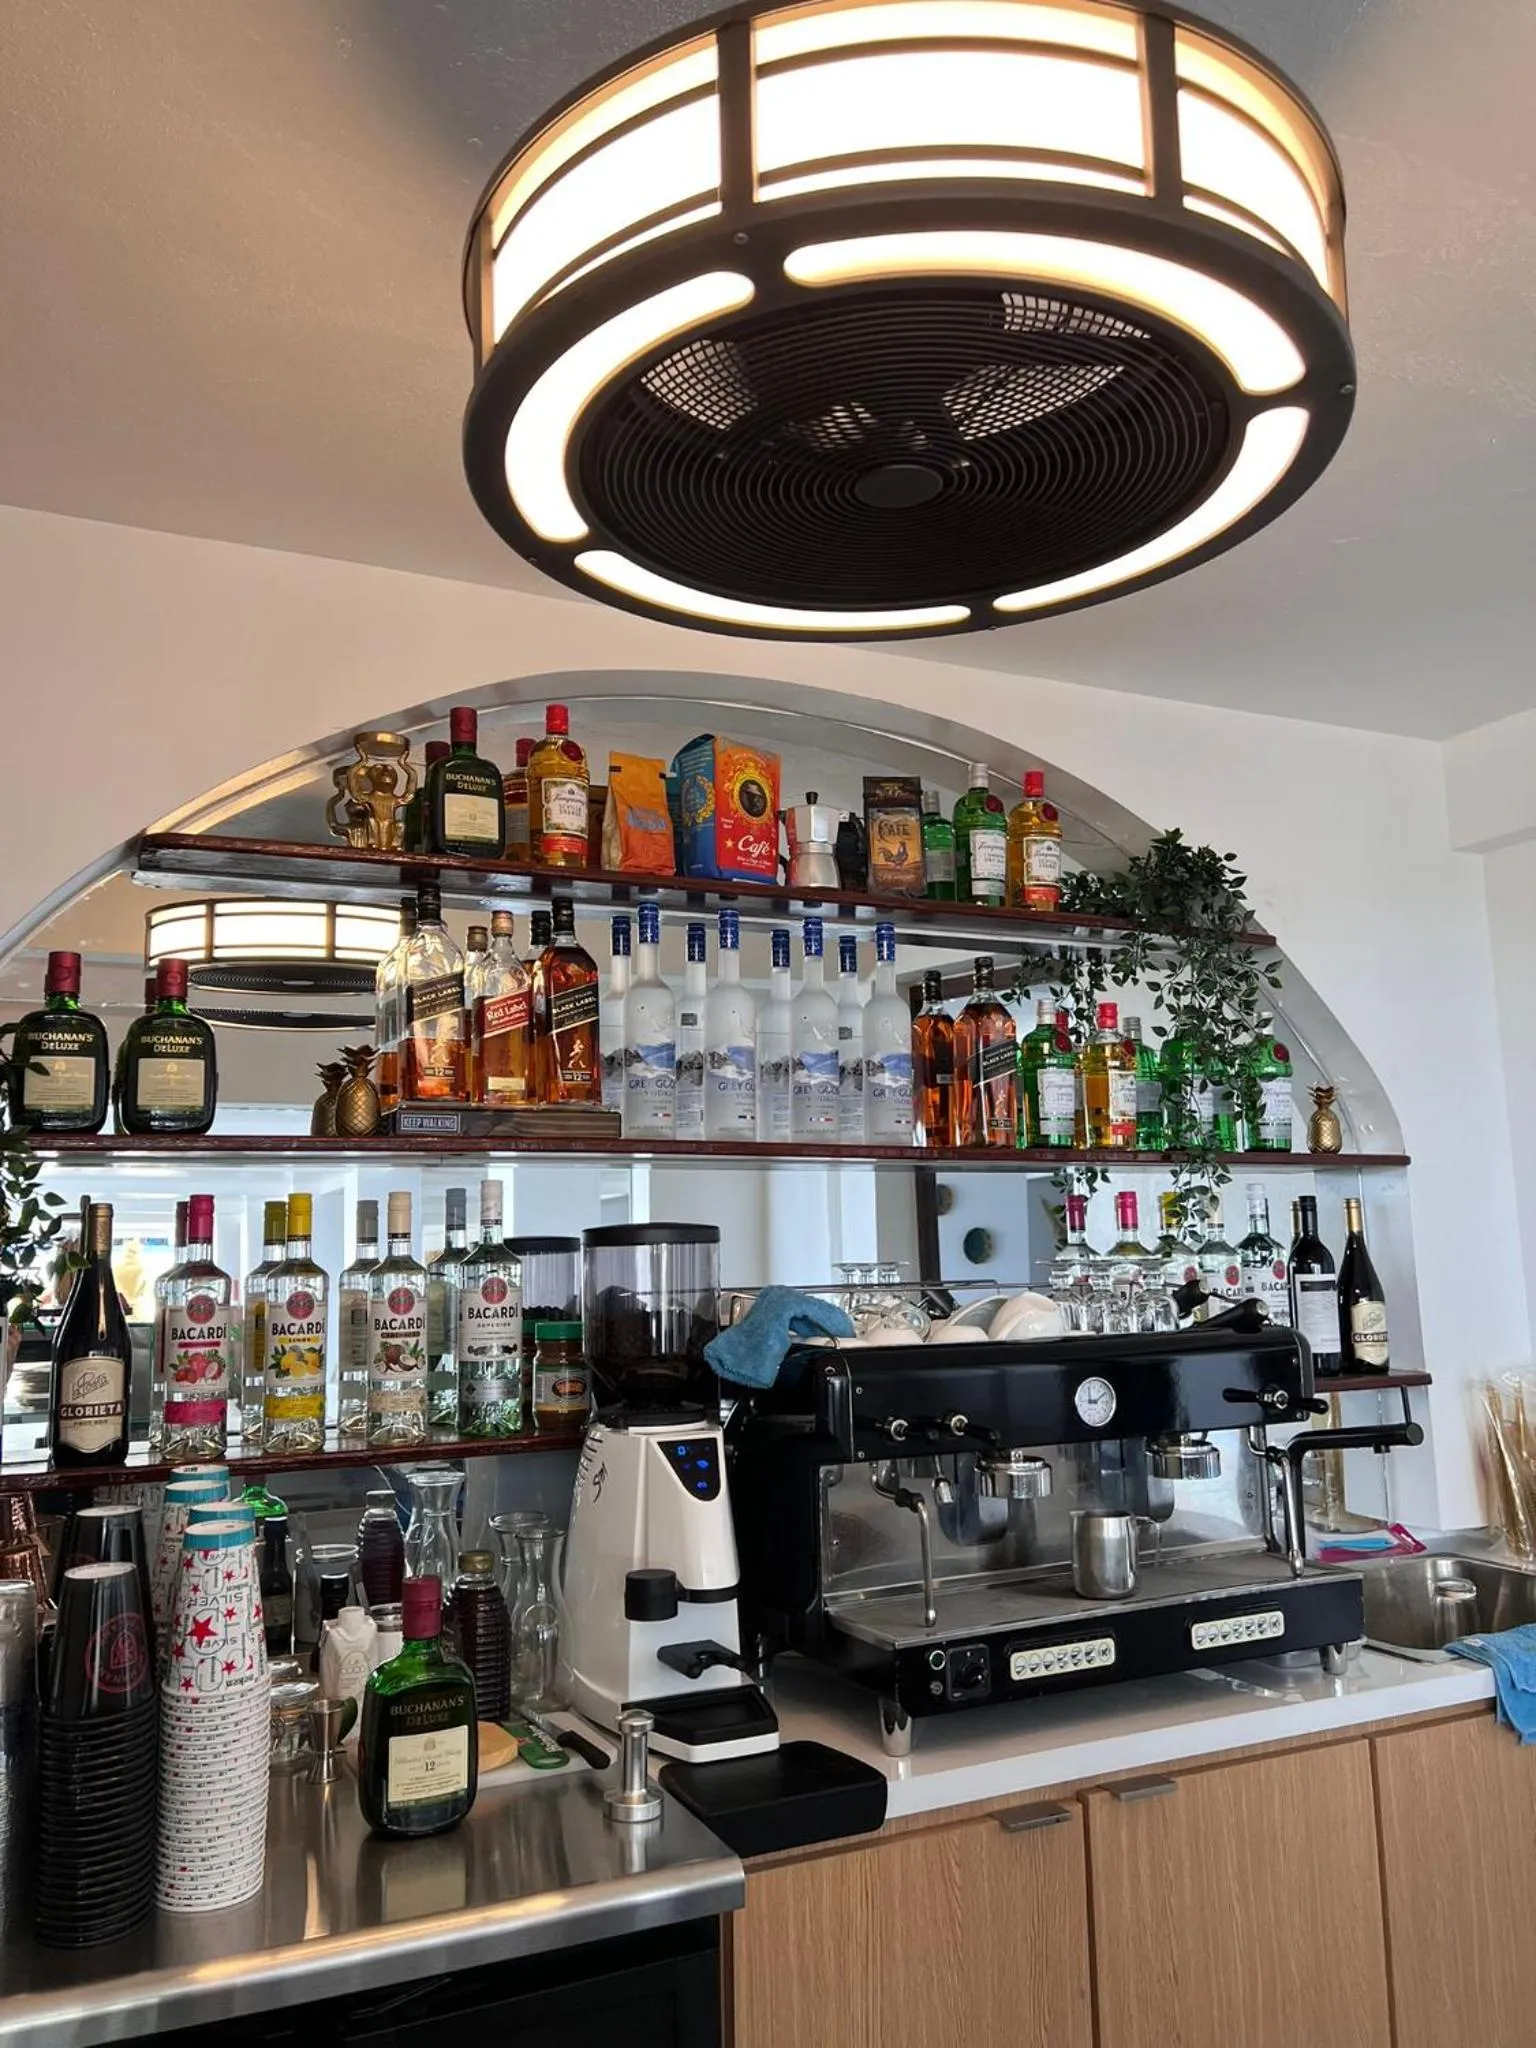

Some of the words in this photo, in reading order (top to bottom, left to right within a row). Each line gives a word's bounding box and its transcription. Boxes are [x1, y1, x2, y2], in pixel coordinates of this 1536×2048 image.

[445, 773, 496, 786] BUCHANAN'S
[737, 834, 770, 857] Café
[437, 986, 462, 998] LABEL
[576, 995, 597, 1007] LABEL
[486, 1008, 504, 1021] Red
[504, 1000, 527, 1015] Label
[28, 1032, 95, 1042] BUCHANAN'S
[140, 1035, 203, 1045] BUCHANAN'S
[403, 1117, 421, 1128] KEEP
[422, 1117, 456, 1128] WALKING
[60, 1403, 122, 1417] GLORIETA
[390, 1695, 464, 1716] BUCHANAN'S
[425, 1760, 436, 1772] 12
